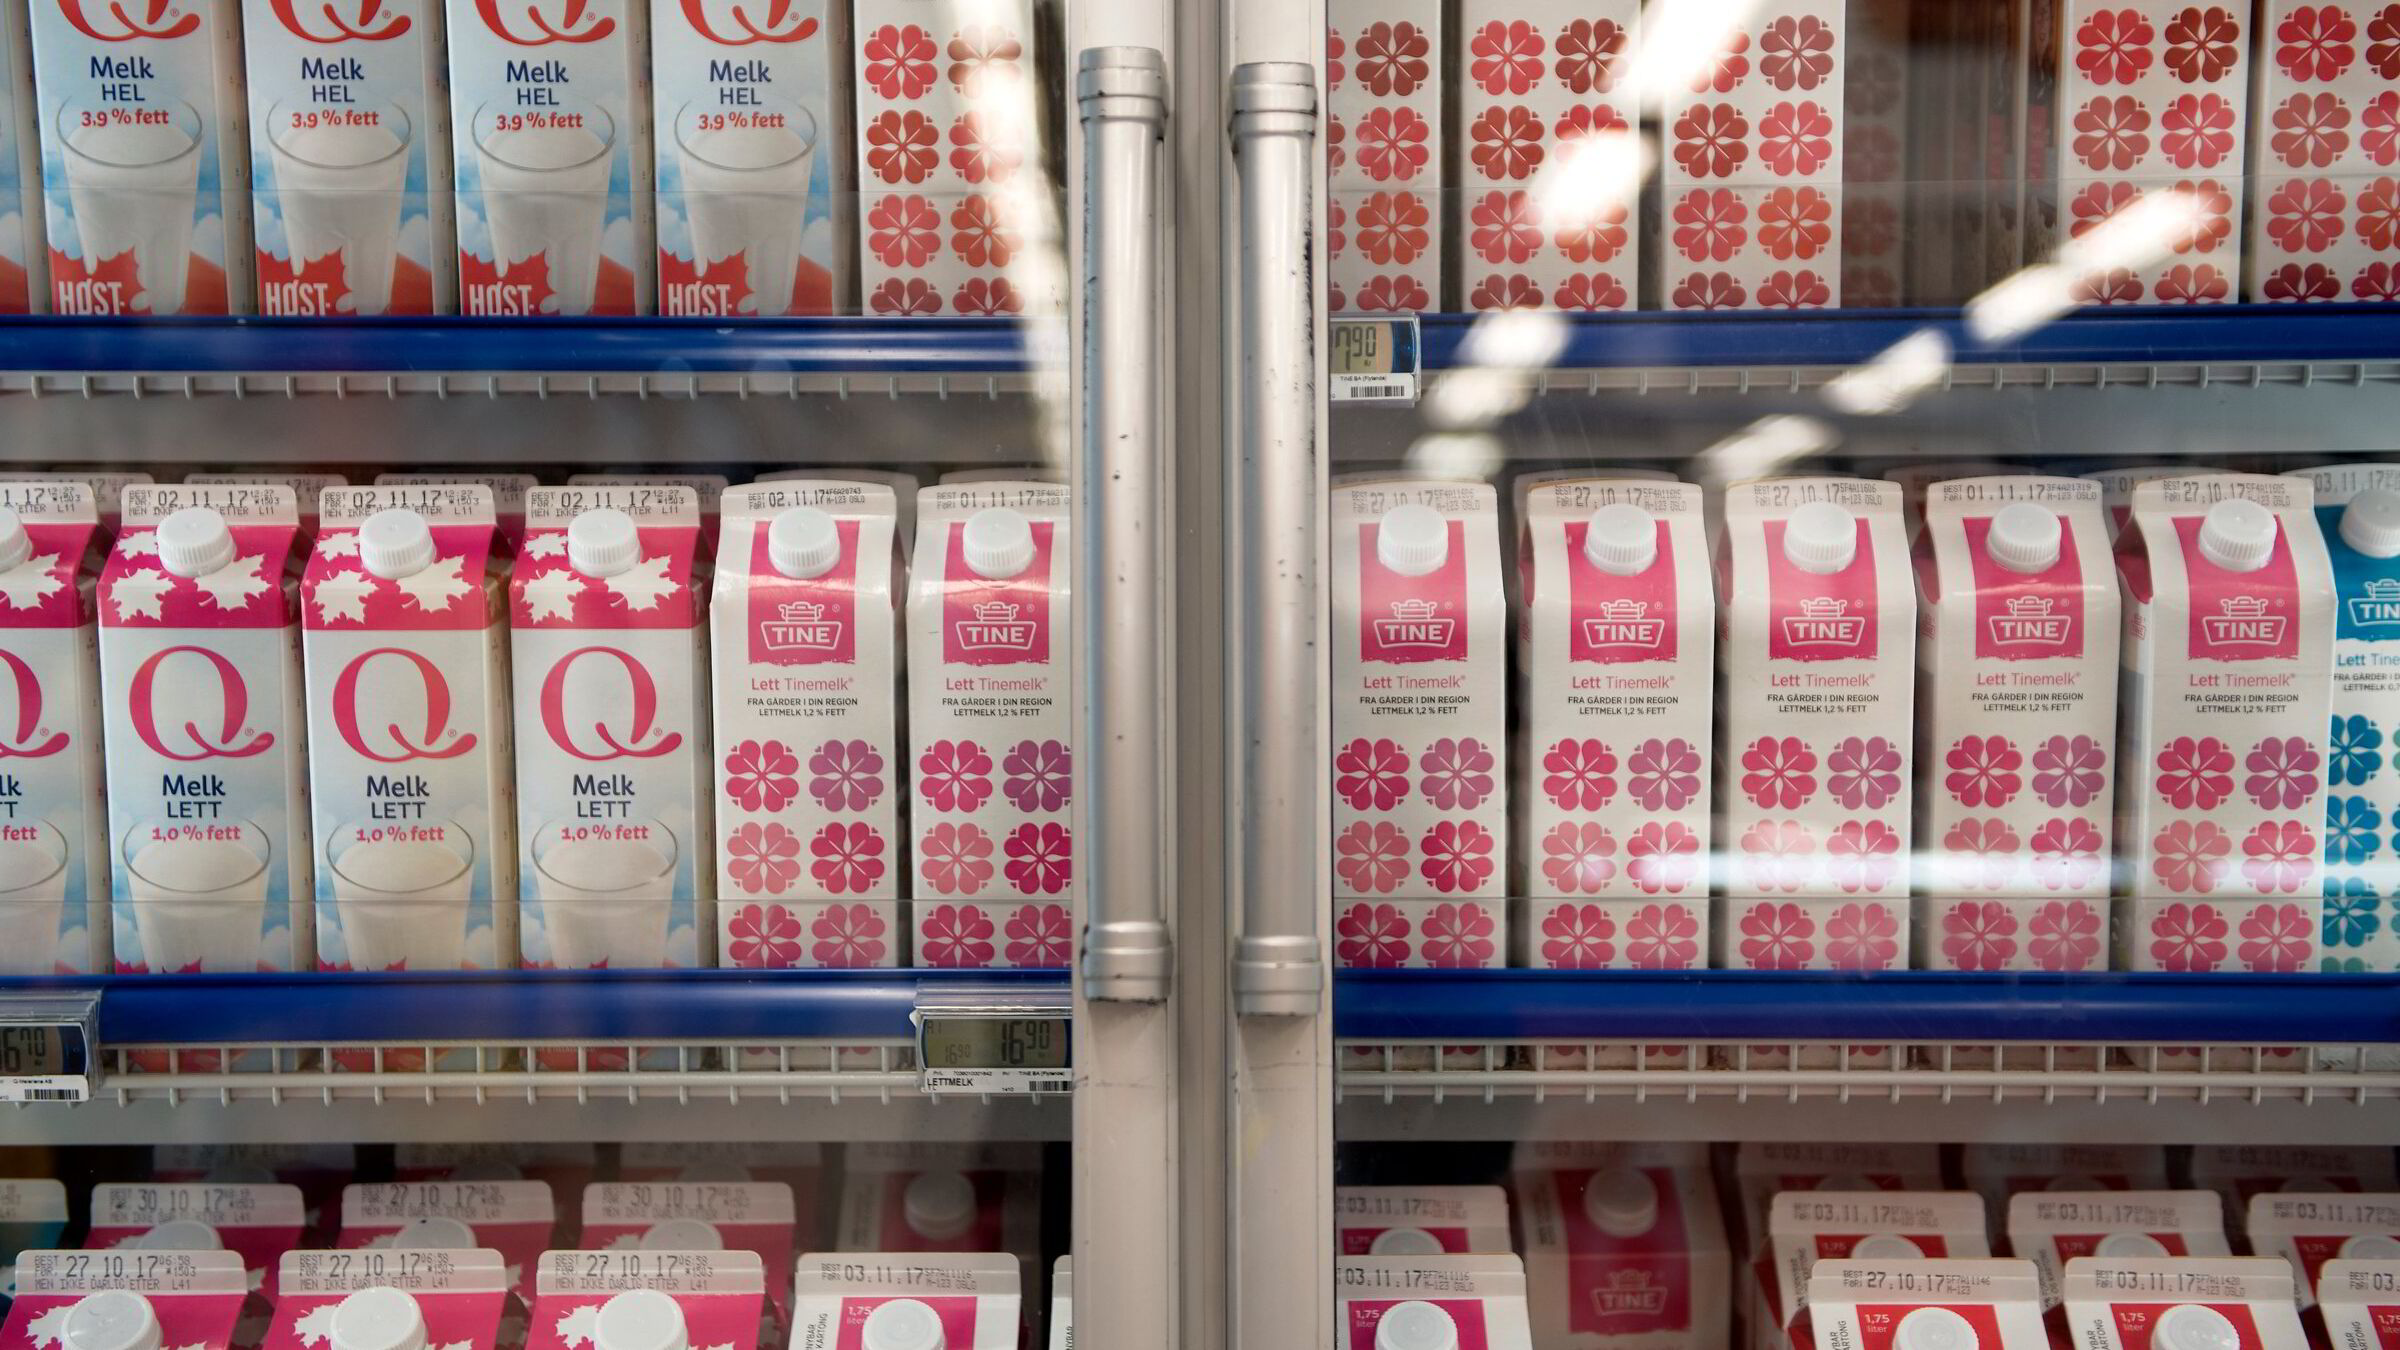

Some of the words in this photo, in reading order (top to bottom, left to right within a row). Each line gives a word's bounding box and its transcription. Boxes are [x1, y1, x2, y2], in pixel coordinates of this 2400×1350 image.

[91, 56, 154, 79] Melk
[302, 57, 364, 80] Melk
[507, 60, 568, 82] Melk
[710, 60, 771, 82] Melk
[102, 84, 145, 101] HEL
[313, 85, 355, 102] HEL
[517, 88, 560, 105] HEL
[720, 88, 761, 105] HEL
[82, 112, 107, 128] 3,9
[112, 108, 131, 124] %
[136, 110, 169, 124] fett
[292, 112, 318, 129] 3,9
[322, 110, 341, 125] %
[346, 110, 379, 125] fett
[496, 115, 522, 130] 3,9
[526, 112, 545, 128] %
[550, 113, 583, 128] fett
[699, 114, 724, 130] 3,9
[729, 112, 747, 128] %
[752, 112, 784, 128] fett
[961, 490, 1034, 508] 01.11.17
[1967, 484, 2045, 500] 01.11.17
[772, 627, 830, 642] TINE
[967, 627, 1024, 642] TINE
[1385, 624, 1442, 640] TINE
[1595, 625, 1653, 640] TINE
[1794, 622, 1852, 638] TINE
[2000, 622, 2058, 637] TINE
[2214, 622, 2274, 638] TINE
[2338, 654, 2365, 666] Lett
[752, 678, 779, 690] Lett
[946, 678, 974, 690] Lett
[1364, 676, 1392, 688] Lett
[1573, 676, 1600, 688] Lett
[1772, 674, 1800, 687] Lett
[1977, 673, 2006, 685] Lett
[2190, 674, 2219, 686] Lett
[129, 645, 275, 761] Q
[333, 648, 477, 763] Q
[540, 646, 682, 760] Q
[767, 697, 800, 706] GÅRDER
[1588, 696, 1622, 704] GÅRDER
[1787, 694, 1822, 702] GÅRDER
[999, 709, 1008, 717] 1,2
[1416, 707, 1426, 715] 1,2
[162, 774, 226, 796] Melk
[366, 775, 430, 797] Melk
[572, 774, 635, 796] Melk
[167, 801, 222, 818] LETT
[371, 802, 426, 819] LETT
[577, 801, 631, 817] LETT
[3, 825, 36, 840] fett
[152, 827, 178, 842] 1,0
[183, 825, 203, 840] %
[206, 825, 240, 840] fett
[356, 828, 382, 843] 1,0
[387, 827, 406, 841] %
[410, 827, 444, 841] fett
[561, 826, 587, 841] 1,0
[592, 825, 611, 840] %
[616, 825, 649, 840] fett
[927, 1078, 973, 1086] LETTMELK
[1346, 1268, 1422, 1287] 03.11.17
[1867, 1272, 1945, 1292] 27.10.17
[2117, 1271, 2195, 1292] 03.11.17
[1602, 1292, 1656, 1308] TINE
[1356, 1310, 1380, 1319] 1,75
[1864, 1314, 1890, 1323] 1,75
[2120, 1312, 2145, 1322] 1,75
